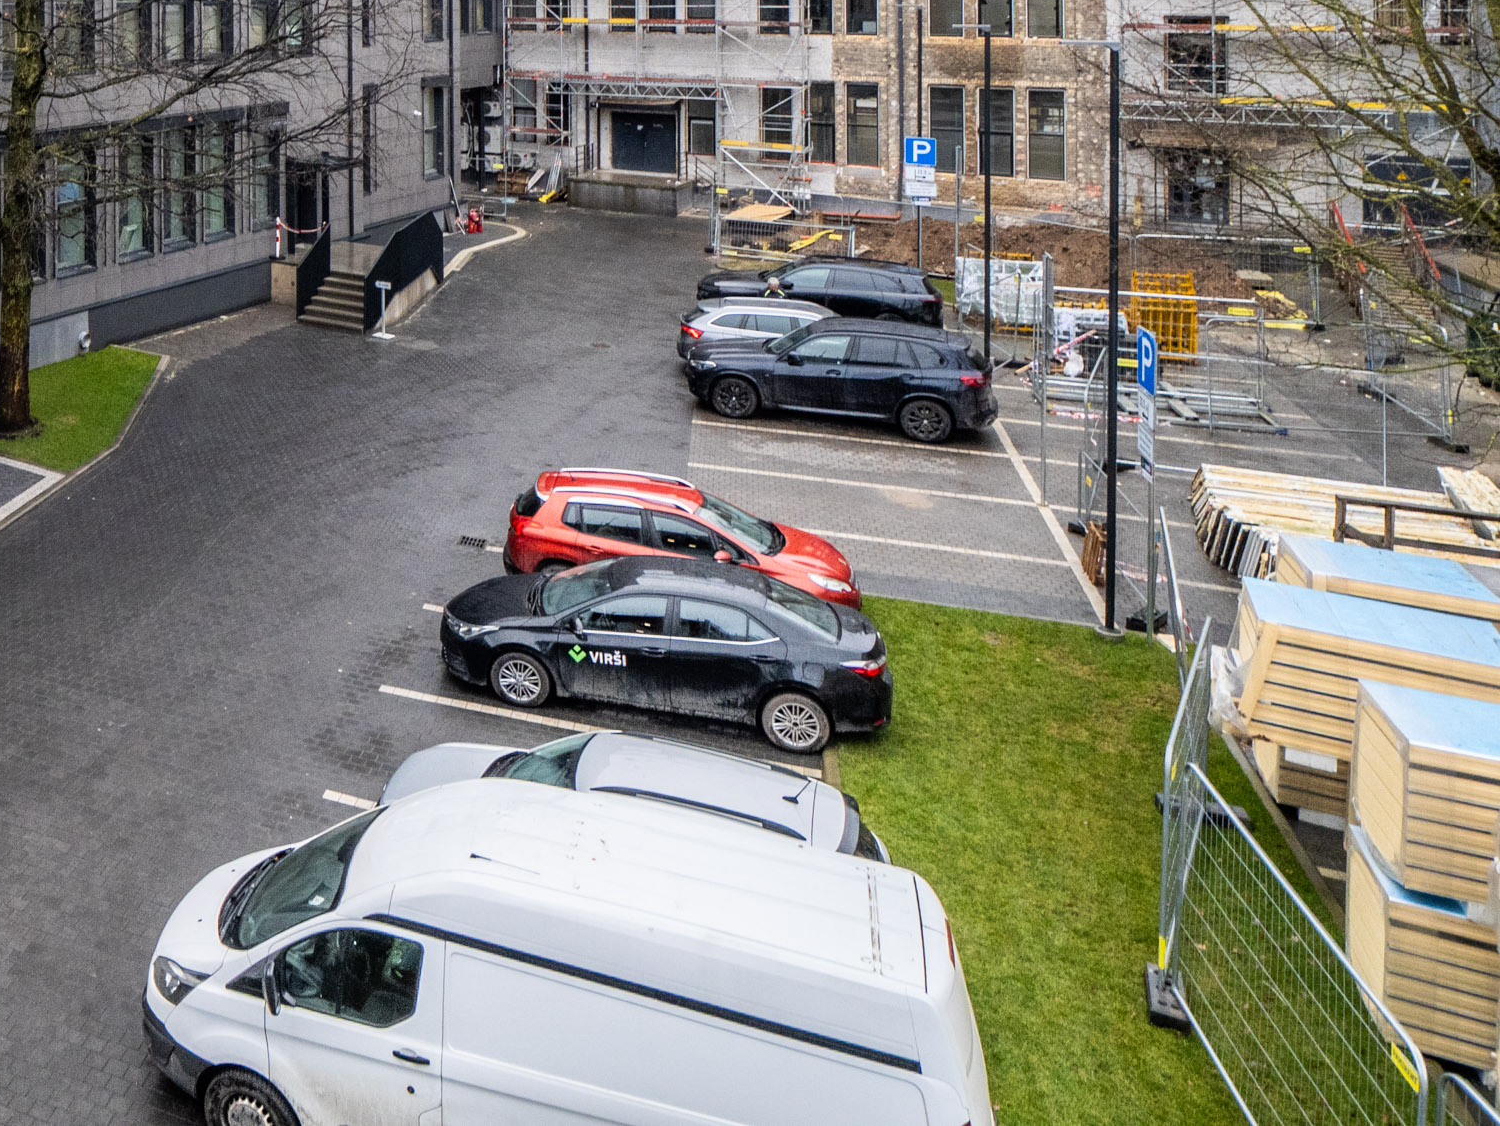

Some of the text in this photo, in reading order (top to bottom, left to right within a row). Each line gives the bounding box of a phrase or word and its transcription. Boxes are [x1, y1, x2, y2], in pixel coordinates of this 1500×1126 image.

[913, 140, 931, 162] P
[1142, 336, 1152, 381] P
[589, 650, 627, 666] VIRŠI
